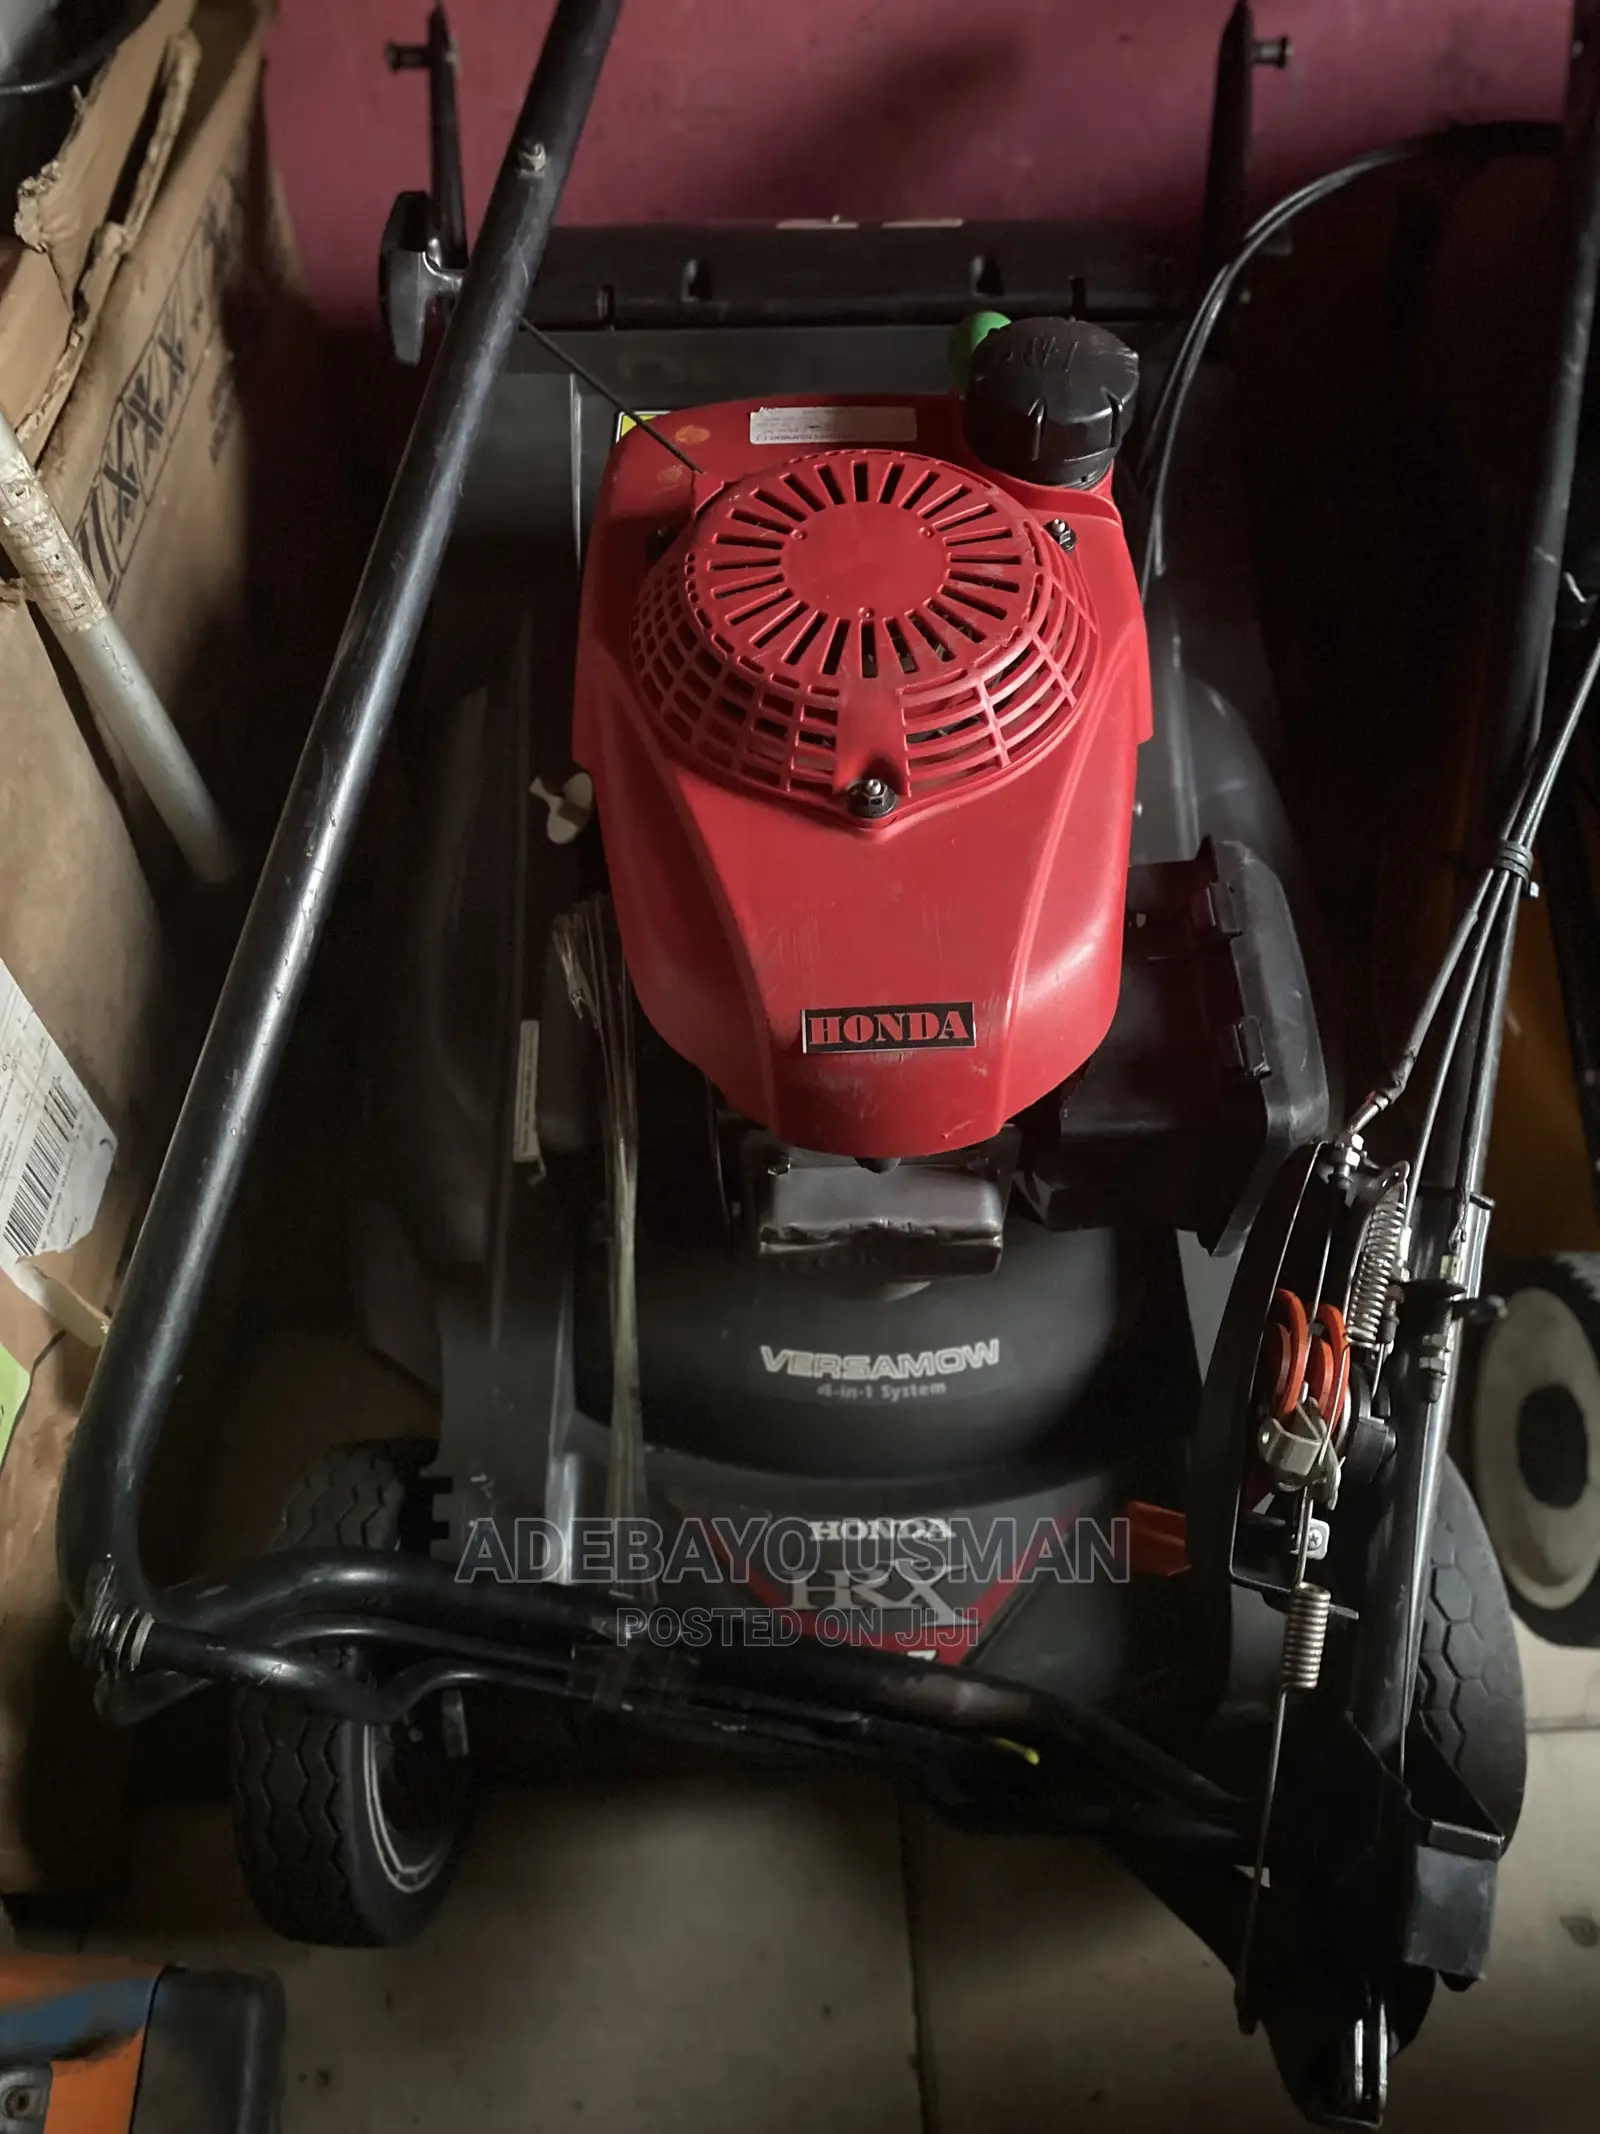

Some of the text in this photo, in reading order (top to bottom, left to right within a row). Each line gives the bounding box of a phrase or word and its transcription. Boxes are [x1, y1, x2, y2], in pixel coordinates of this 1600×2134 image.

[808, 1010, 970, 1045] HONDA
[760, 1338, 1000, 1380] VERSAMOW
[880, 1381, 947, 1402] System
[808, 1518, 956, 1541] HONDA
